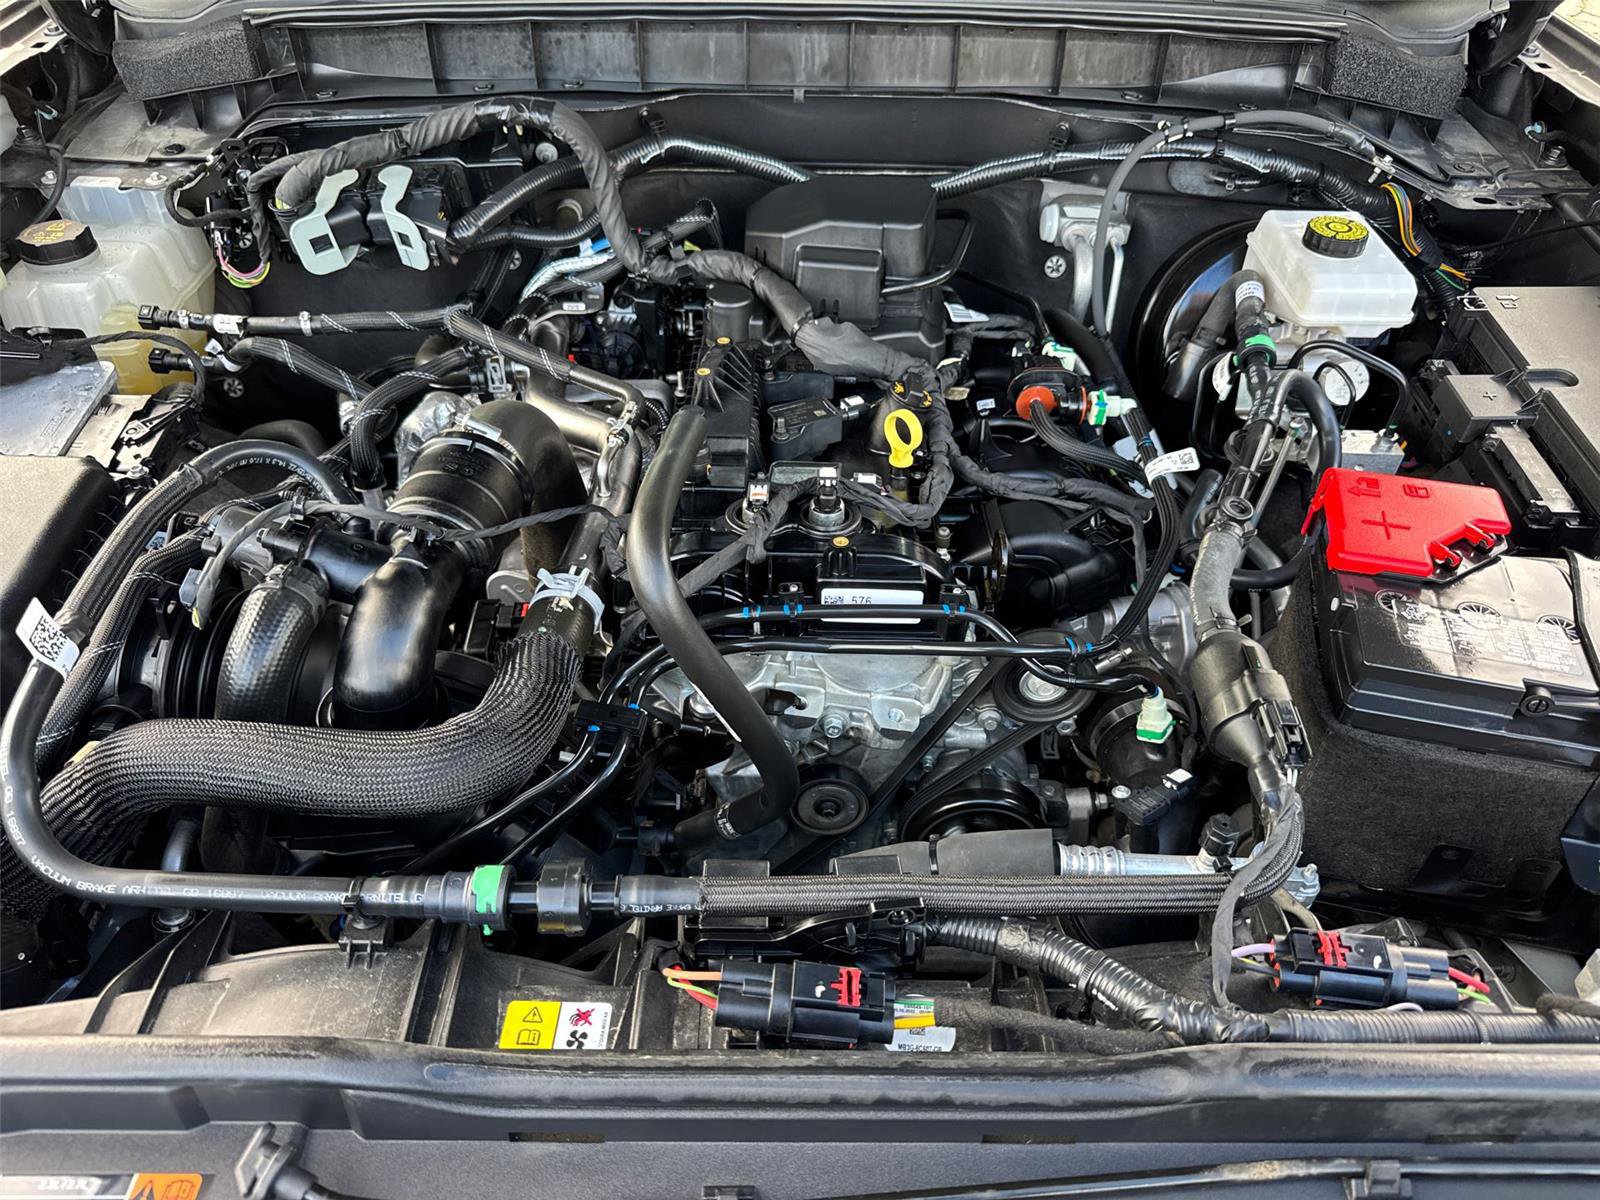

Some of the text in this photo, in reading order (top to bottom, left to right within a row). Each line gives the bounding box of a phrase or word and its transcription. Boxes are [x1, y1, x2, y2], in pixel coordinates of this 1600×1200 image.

[31, 855, 72, 887] VACUUM
[75, 880, 117, 894] BRAKE
[413, 892, 425, 904] G
